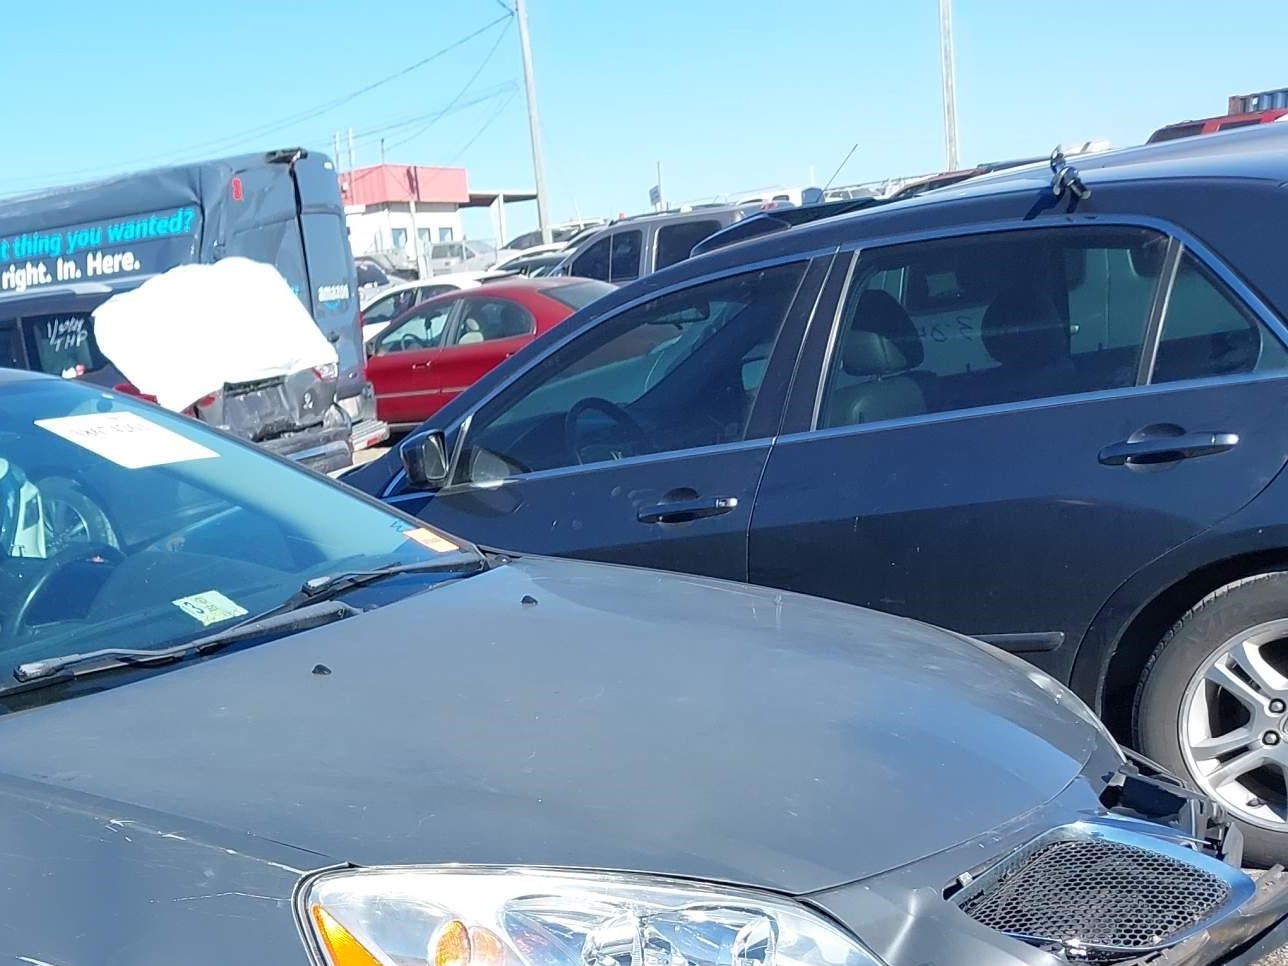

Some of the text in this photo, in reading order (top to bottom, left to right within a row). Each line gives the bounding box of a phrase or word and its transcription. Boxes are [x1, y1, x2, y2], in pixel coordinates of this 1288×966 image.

[14, 232, 62, 256] thing
[67, 228, 102, 254] you
[108, 208, 195, 241] wanted?
[2, 262, 52, 292] right.
[57, 256, 82, 281] In.
[87, 251, 141, 276] Here.
